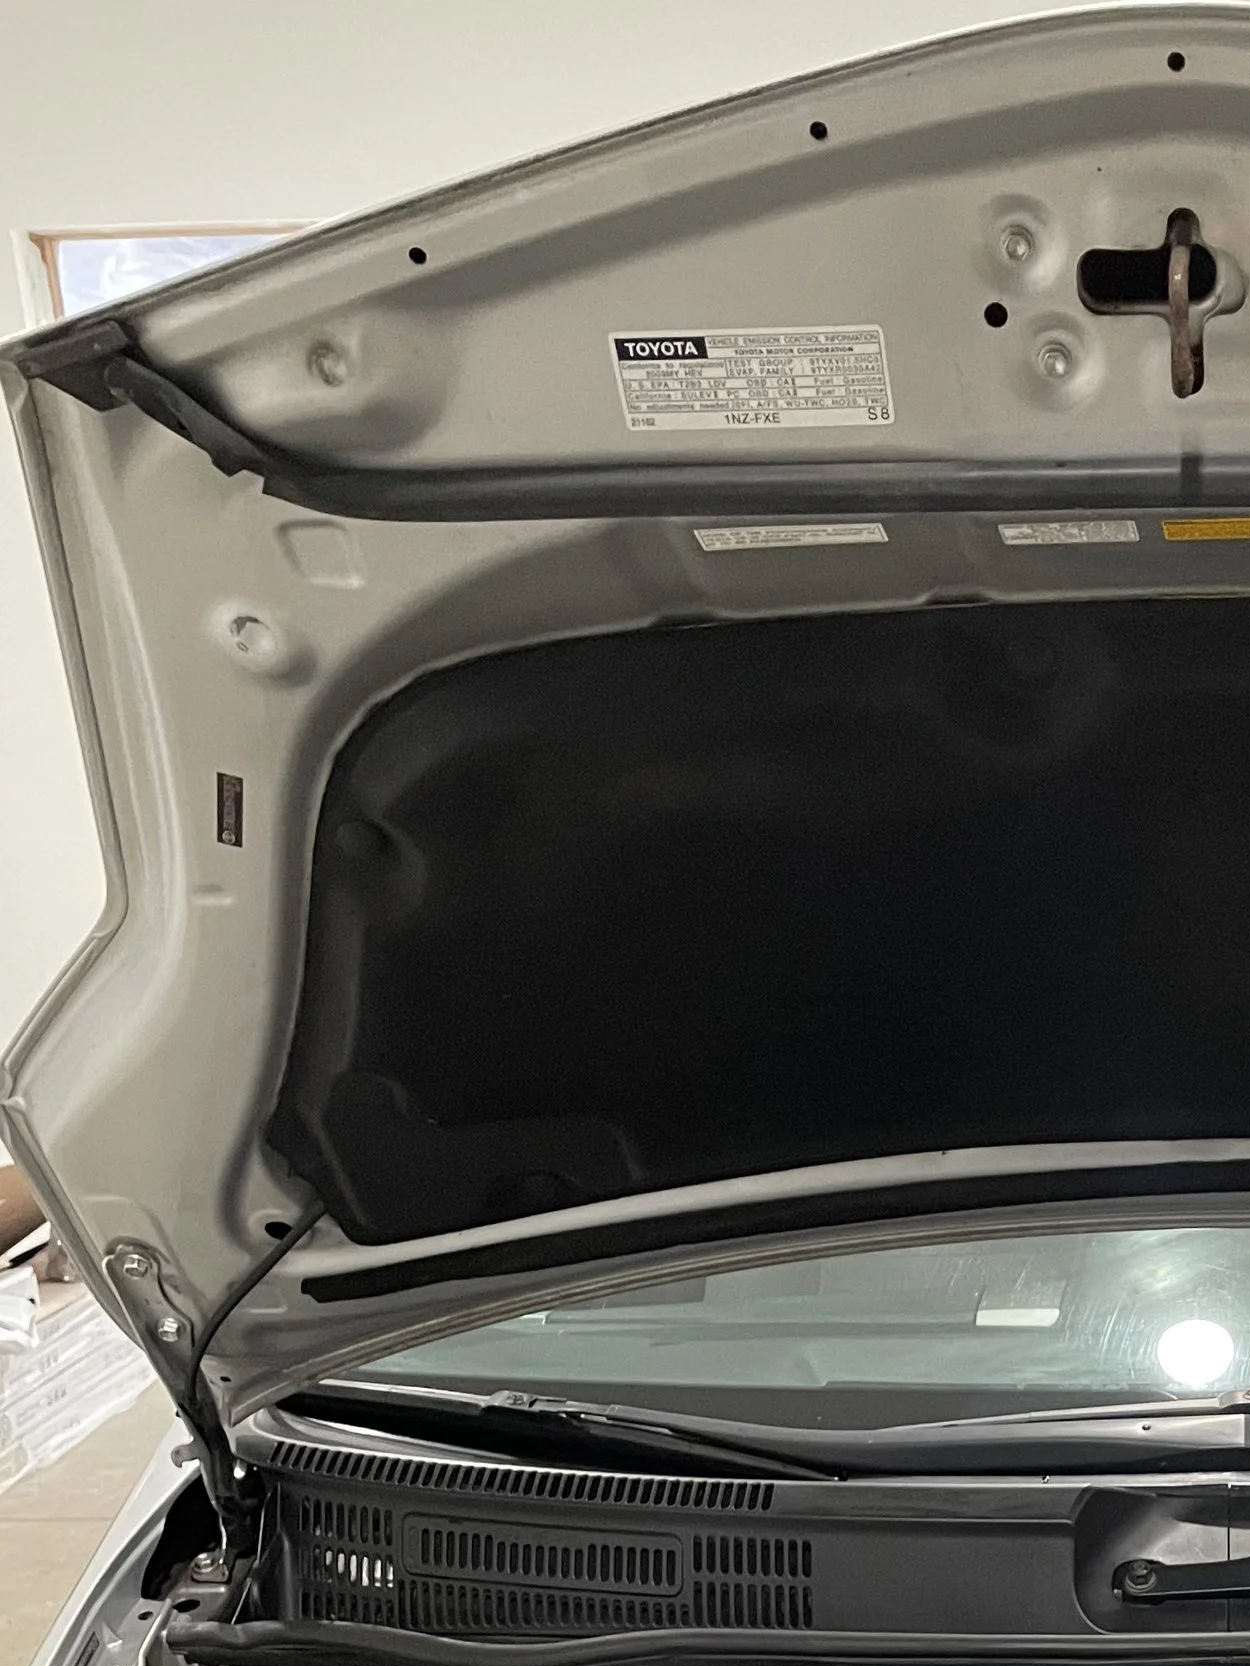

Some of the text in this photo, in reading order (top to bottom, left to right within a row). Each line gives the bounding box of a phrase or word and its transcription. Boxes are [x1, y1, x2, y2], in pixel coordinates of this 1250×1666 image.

[624, 341, 698, 357] TOYOTA
[734, 346, 854, 356] TOYOTA MOTOR CORPORATION
[728, 358, 752, 367] TEST
[724, 412, 781, 425] 1NZ-FXE
